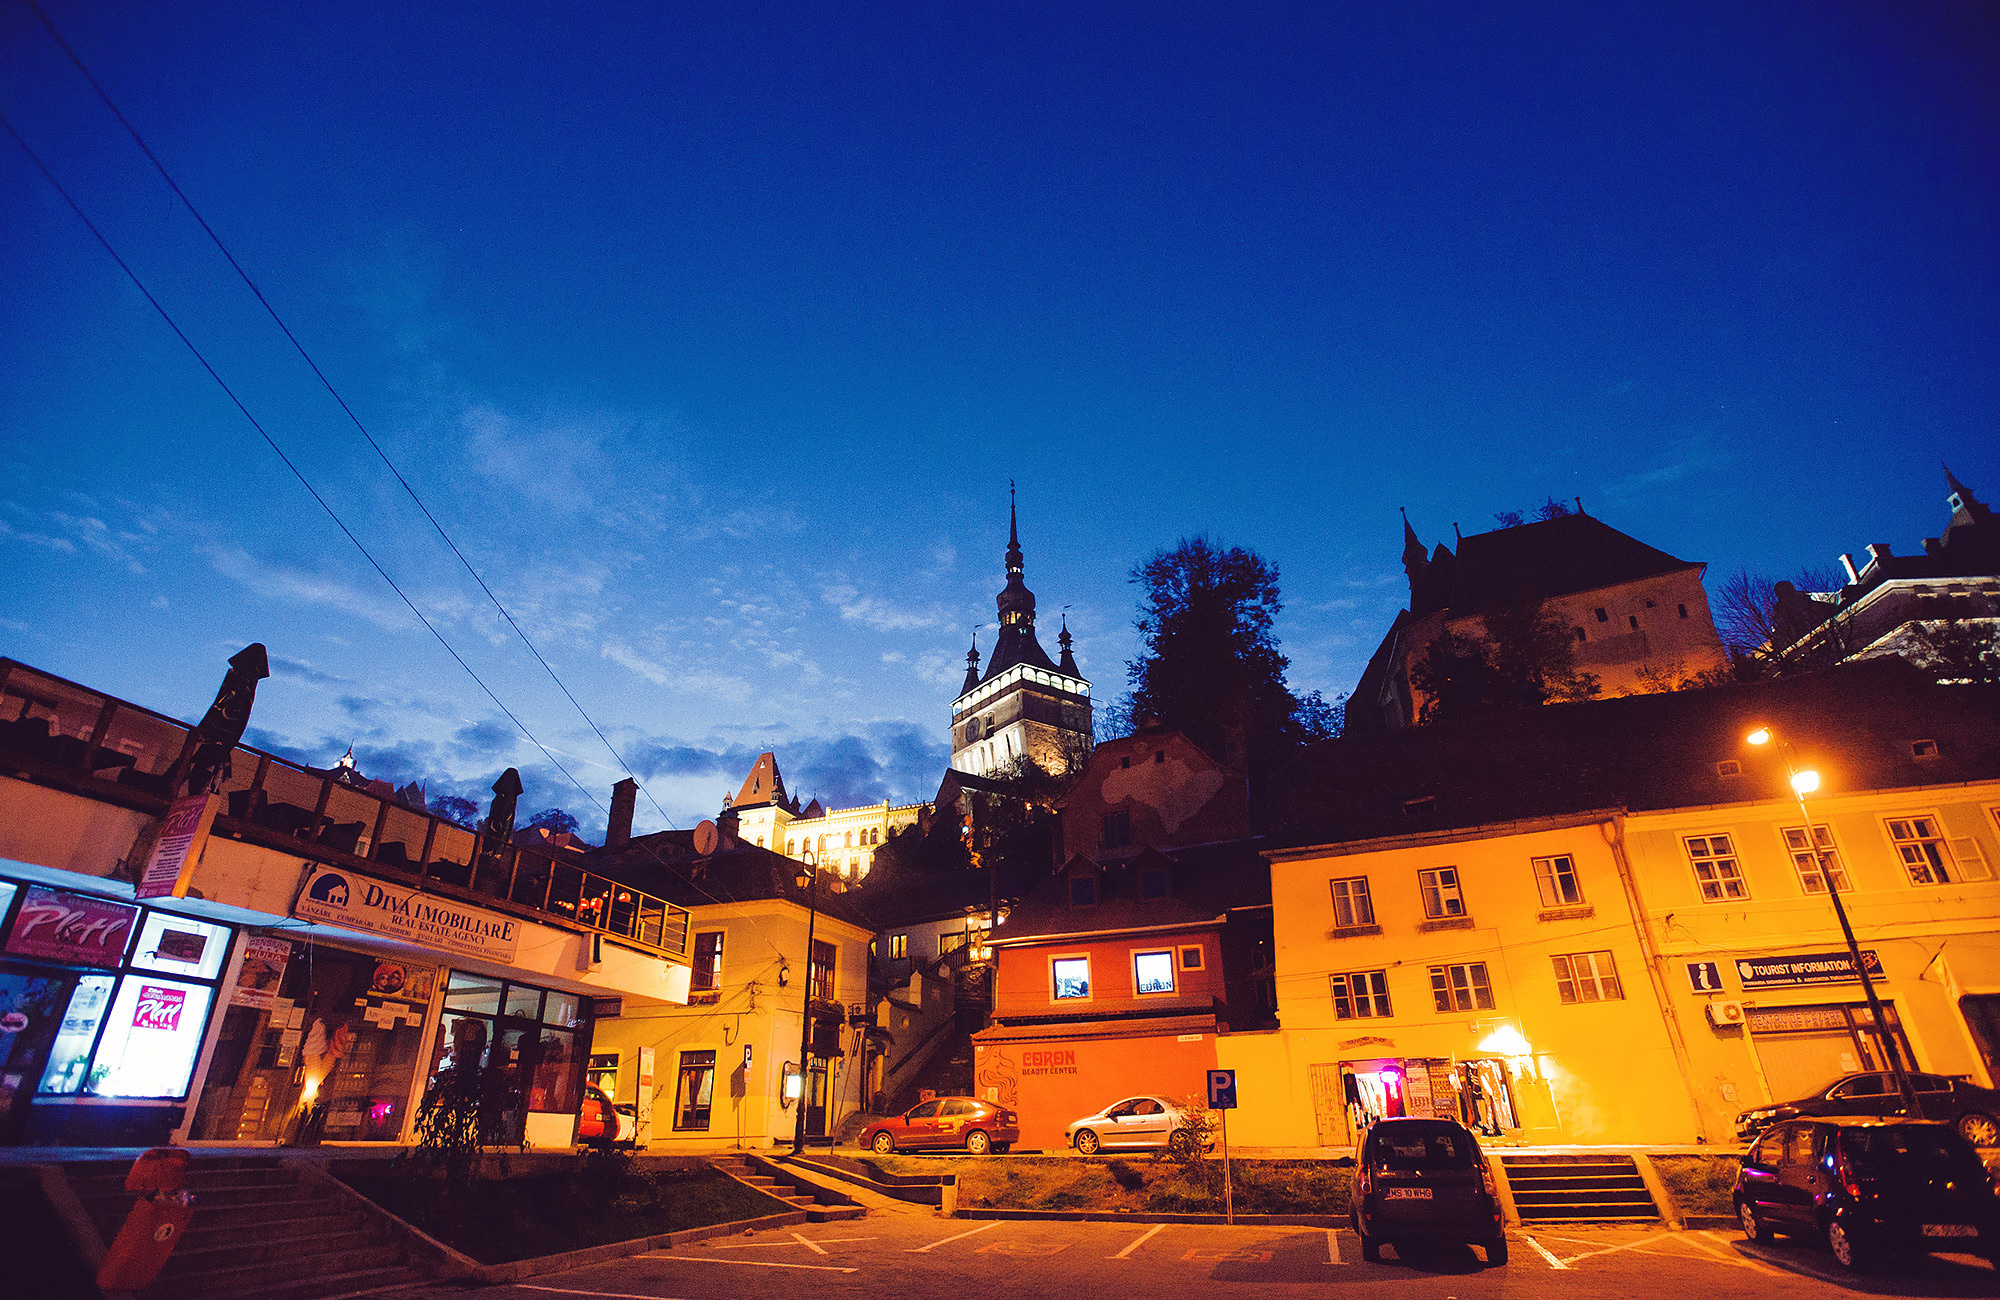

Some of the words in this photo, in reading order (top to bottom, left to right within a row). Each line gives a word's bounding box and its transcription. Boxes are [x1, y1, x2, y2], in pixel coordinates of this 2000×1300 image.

[391, 914, 416, 929] REAL
[419, 921, 451, 938] ESTATE
[452, 930, 486, 946] AGENCY
[249, 938, 290, 953] PENSIUNE
[1753, 963, 1791, 976] TOURIST
[1791, 960, 1851, 974] INFORMATION
[1750, 1013, 1787, 1026] CENTRU
[1788, 1012, 1802, 1024] DE
[1803, 1009, 1843, 1023] CAZARE
[1022, 1050, 1076, 1067] CORON
[1022, 1068, 1049, 1076] BEAUTY
[1050, 1066, 1078, 1075] CENTER
[1211, 1071, 1232, 1102] P
